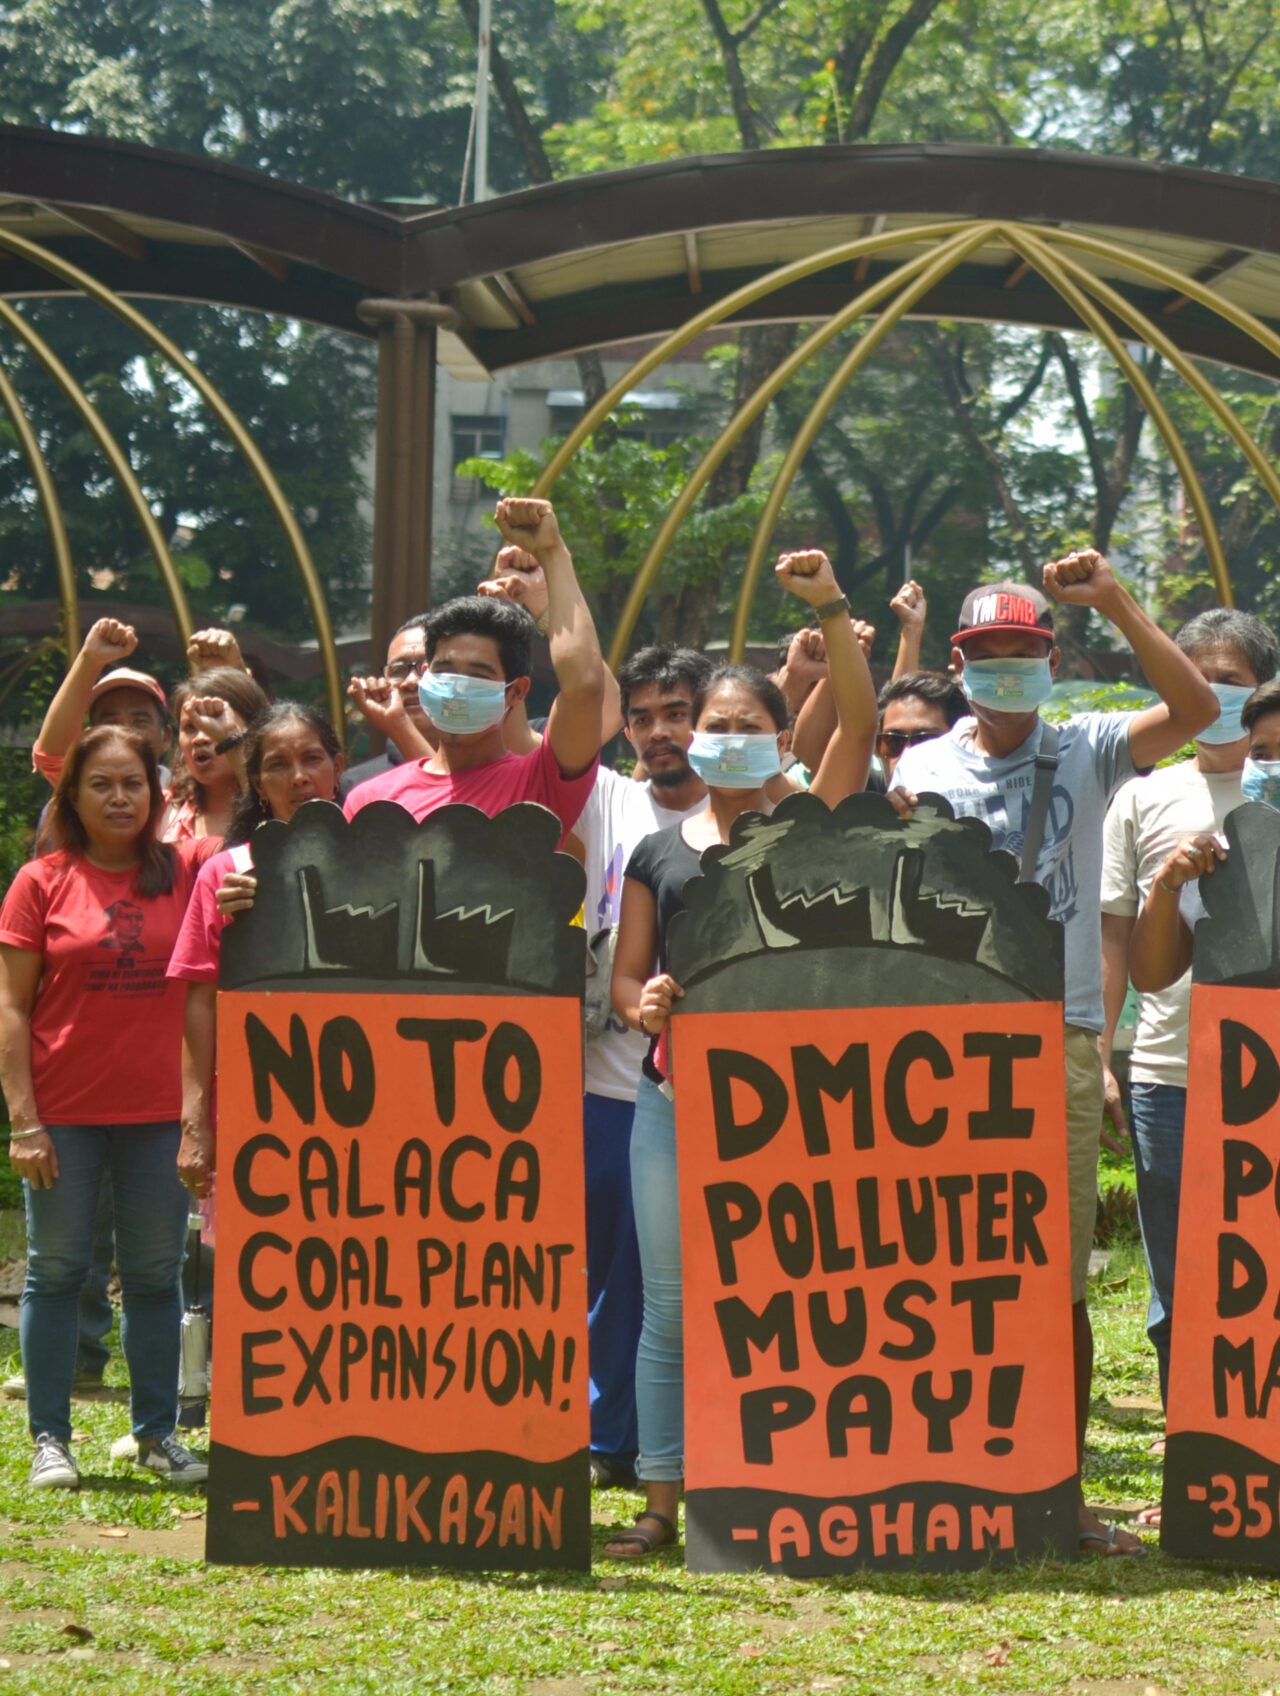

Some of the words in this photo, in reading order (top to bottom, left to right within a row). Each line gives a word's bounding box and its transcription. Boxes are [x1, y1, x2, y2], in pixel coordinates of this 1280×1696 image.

[972, 592, 1036, 626] YMCMB
[1006, 776, 1032, 789] RIDE
[244, 1011, 376, 1128] NO
[395, 1017, 542, 1133] TO
[706, 1030, 1042, 1162] DMCI
[233, 1133, 541, 1223] CALACA
[238, 1231, 403, 1312] COAL
[417, 1238, 575, 1312] PLANT
[703, 1169, 1049, 1286] POLLUTER
[241, 1322, 576, 1417] EXPANSION!
[713, 1274, 1022, 1378] MUST
[739, 1365, 1025, 1466] PAY!
